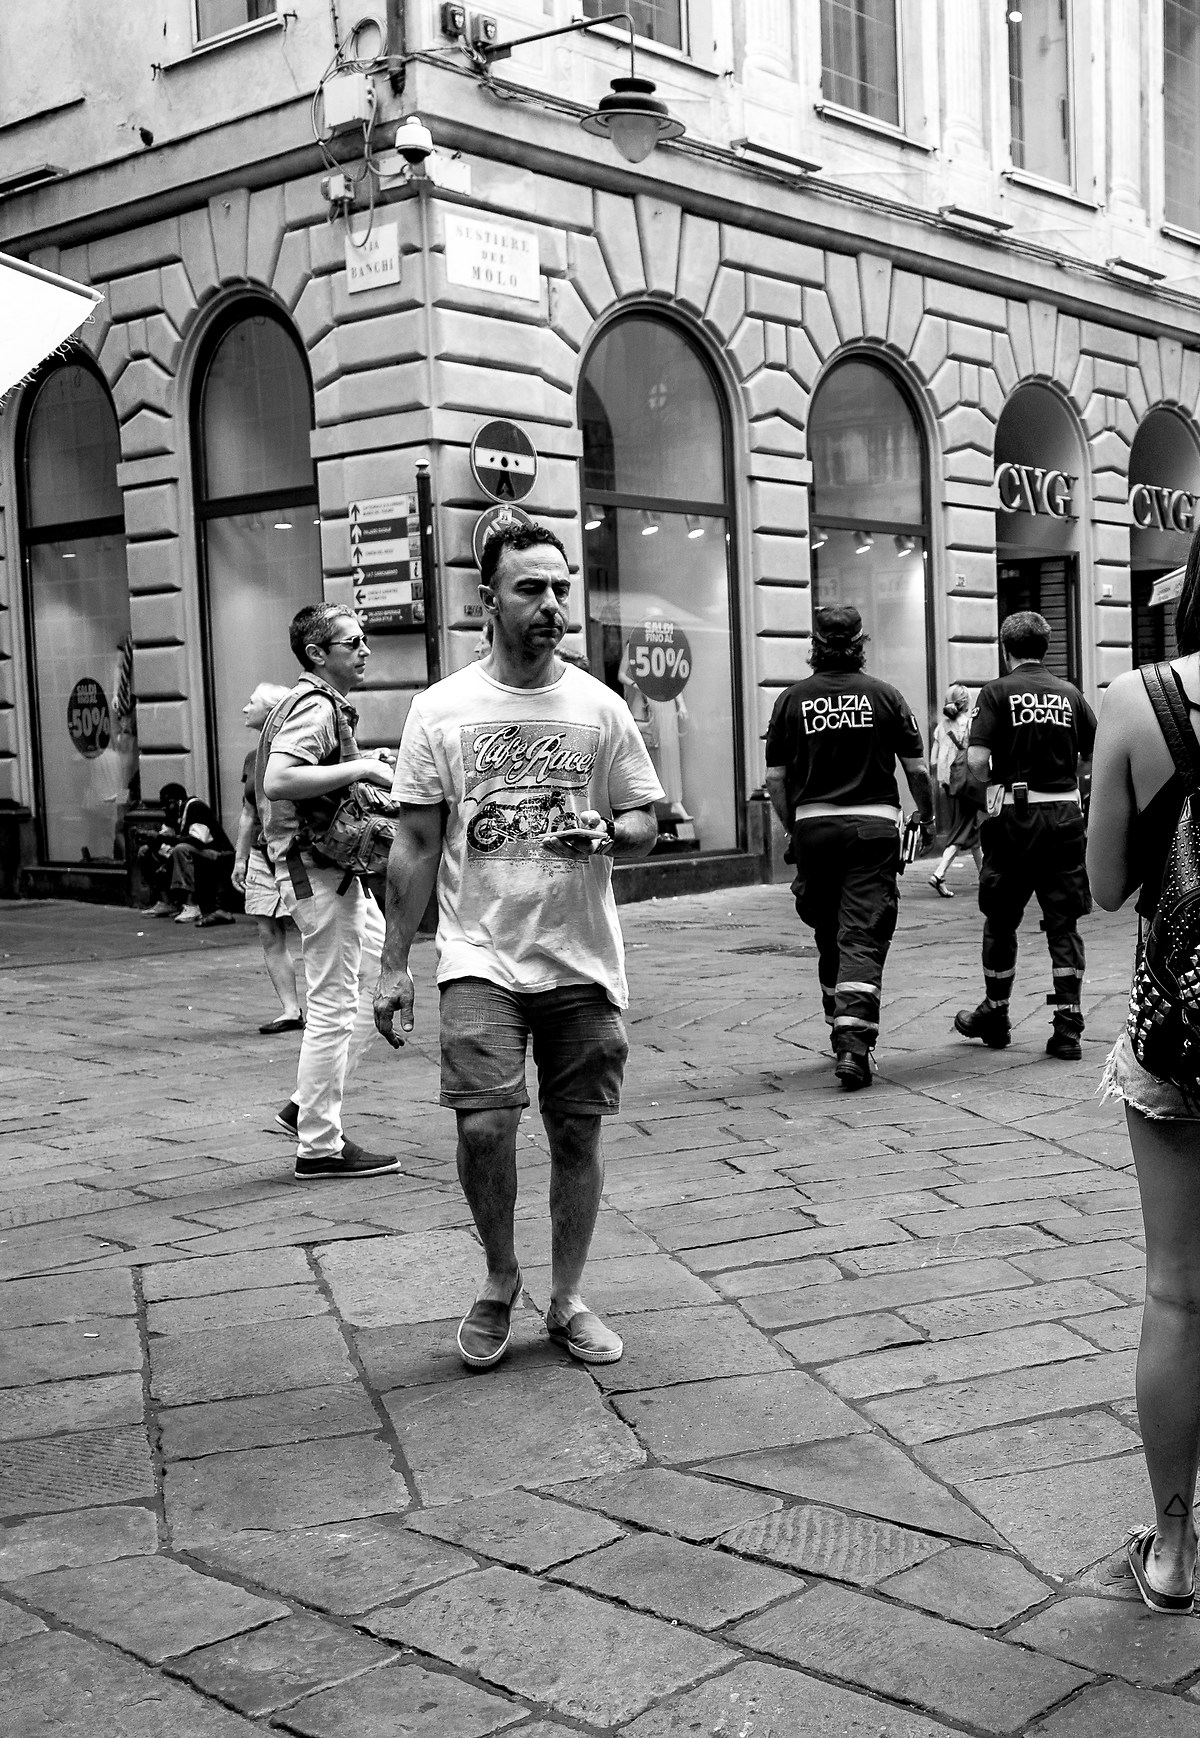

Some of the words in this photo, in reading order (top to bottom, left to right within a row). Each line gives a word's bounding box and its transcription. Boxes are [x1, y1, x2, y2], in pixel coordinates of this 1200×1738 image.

[456, 224, 530, 253] SESTIERE
[481, 250, 506, 264] DEL
[350, 258, 394, 279] BANCHI
[472, 266, 518, 287] MOLO
[995, 462, 1074, 519] CVG
[1129, 484, 1195, 533] CVG
[644, 621, 674, 634] SALDI
[645, 633, 664, 643] FINO
[664, 634, 674, 643] AL
[629, 646, 690, 679] -50%
[801, 694, 873, 717] POLIZIA
[1009, 692, 1073, 712] POLIZIA
[803, 711, 874, 735] LOCALE
[1011, 708, 1073, 727] LOCALE
